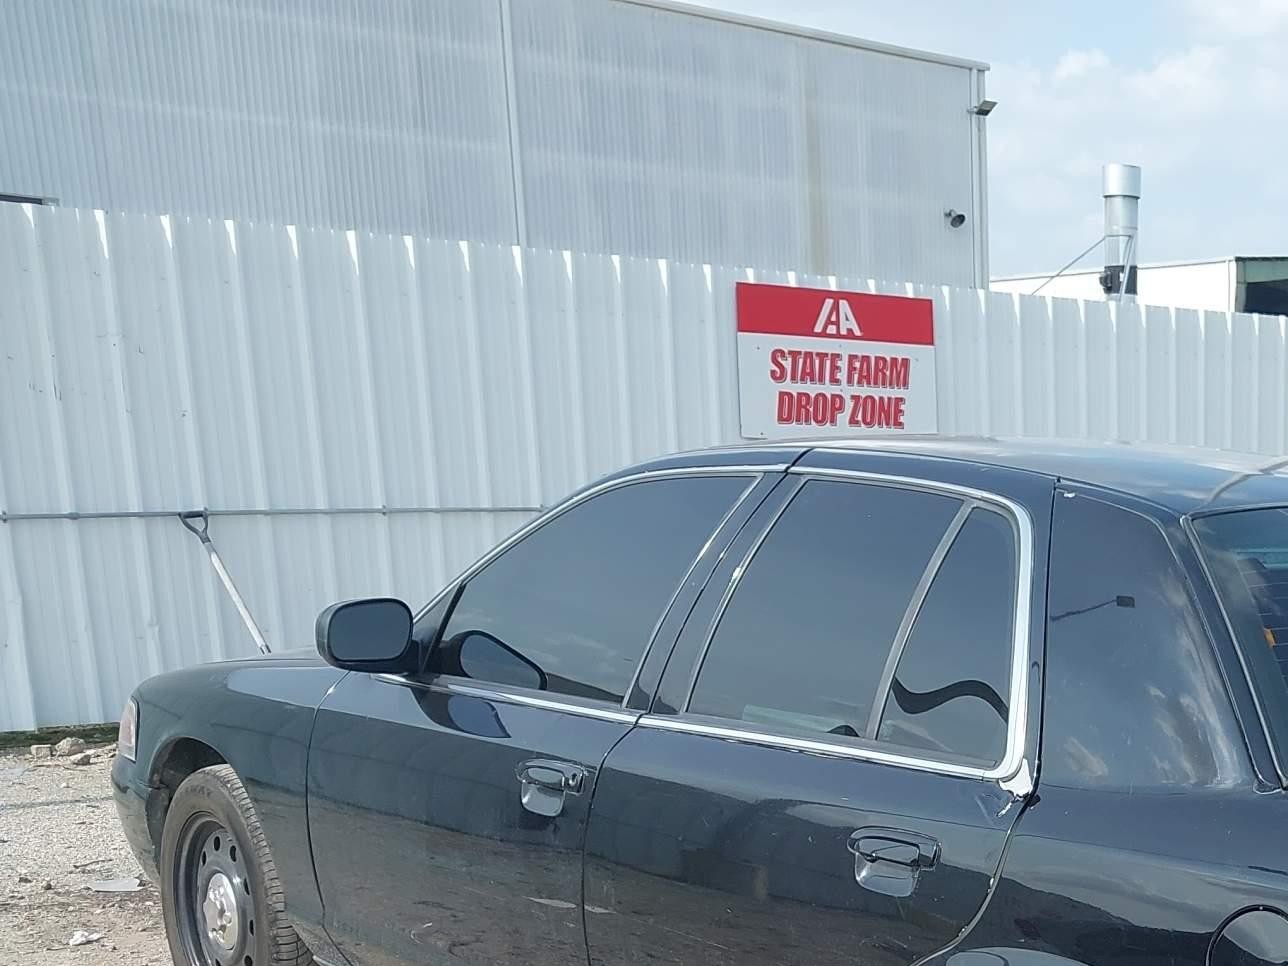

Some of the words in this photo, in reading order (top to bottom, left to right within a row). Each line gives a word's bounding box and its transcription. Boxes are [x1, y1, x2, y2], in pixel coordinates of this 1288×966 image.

[769, 348, 842, 385] STATE
[846, 353, 911, 390] FARM
[776, 390, 845, 427] DROP
[847, 394, 906, 430] ZONE
